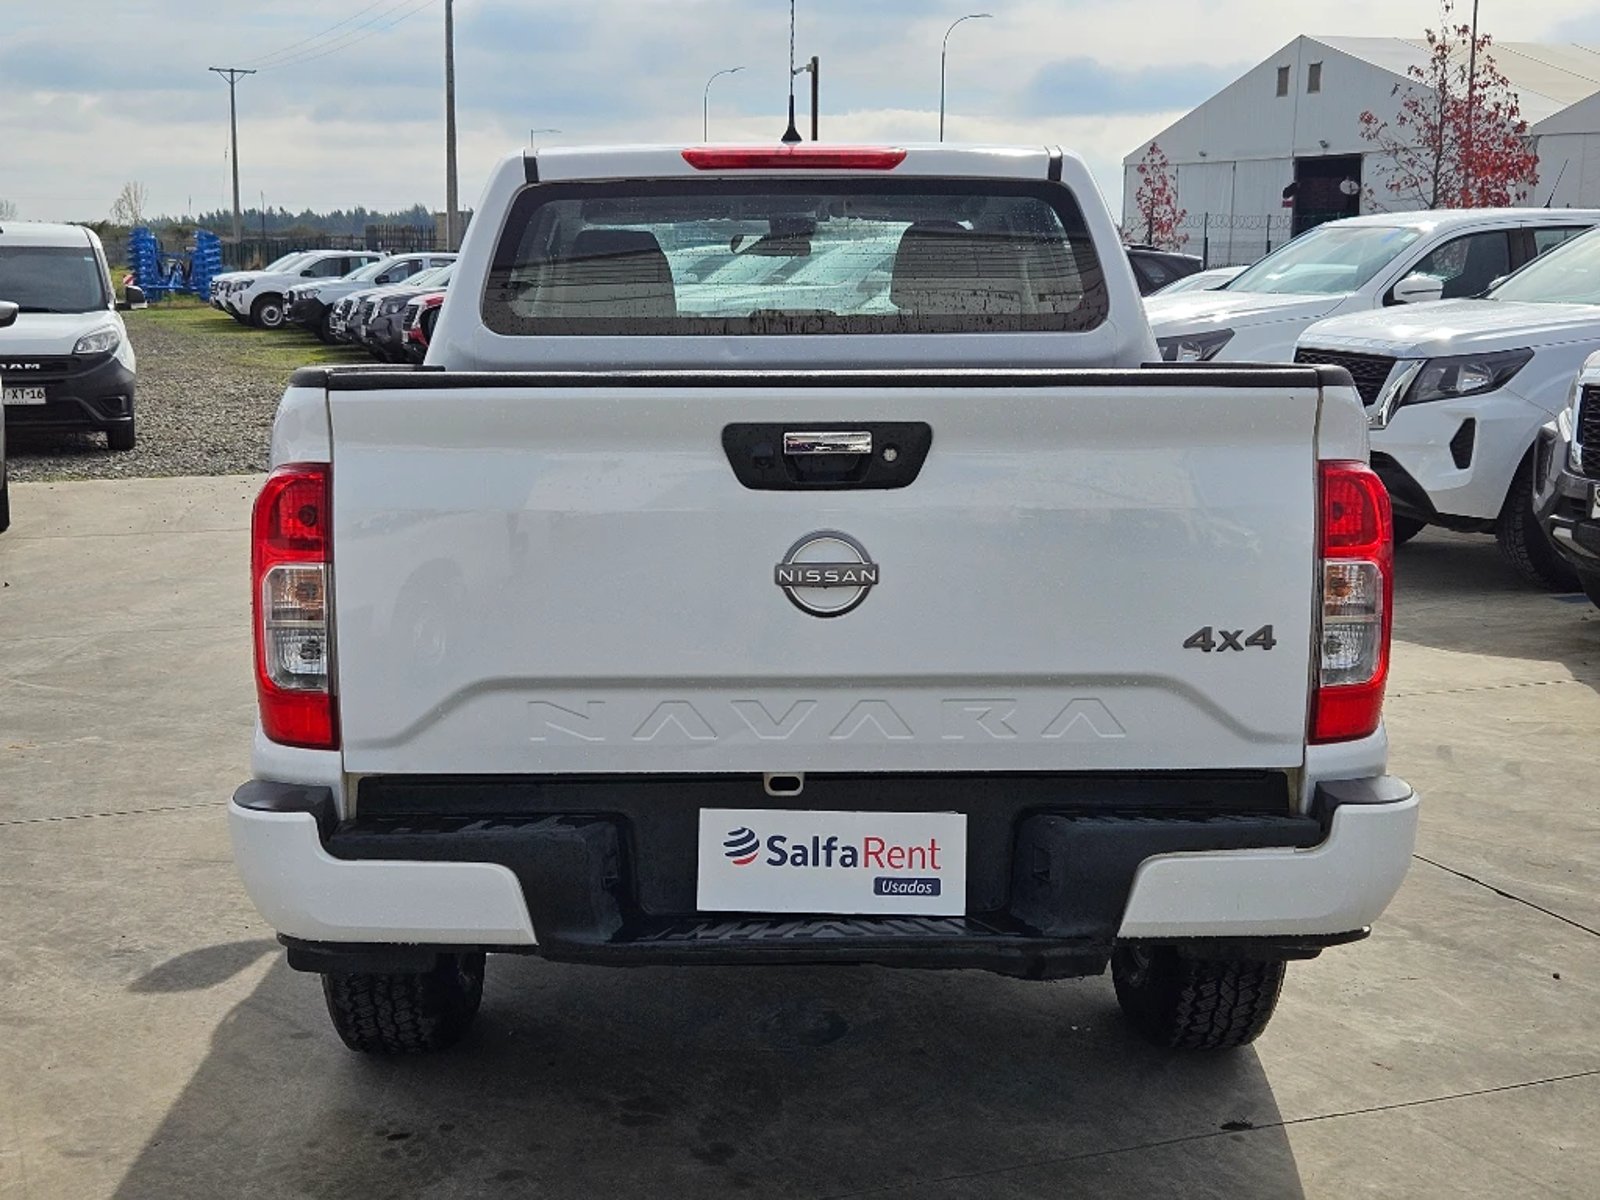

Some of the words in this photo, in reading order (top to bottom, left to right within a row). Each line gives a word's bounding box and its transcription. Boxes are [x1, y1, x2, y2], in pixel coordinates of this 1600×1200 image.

[779, 569, 876, 582] NISSAN
[1182, 624, 1277, 653] 4x4
[527, 697, 1128, 741] NAVARA
[882, 878, 932, 895] Usados
